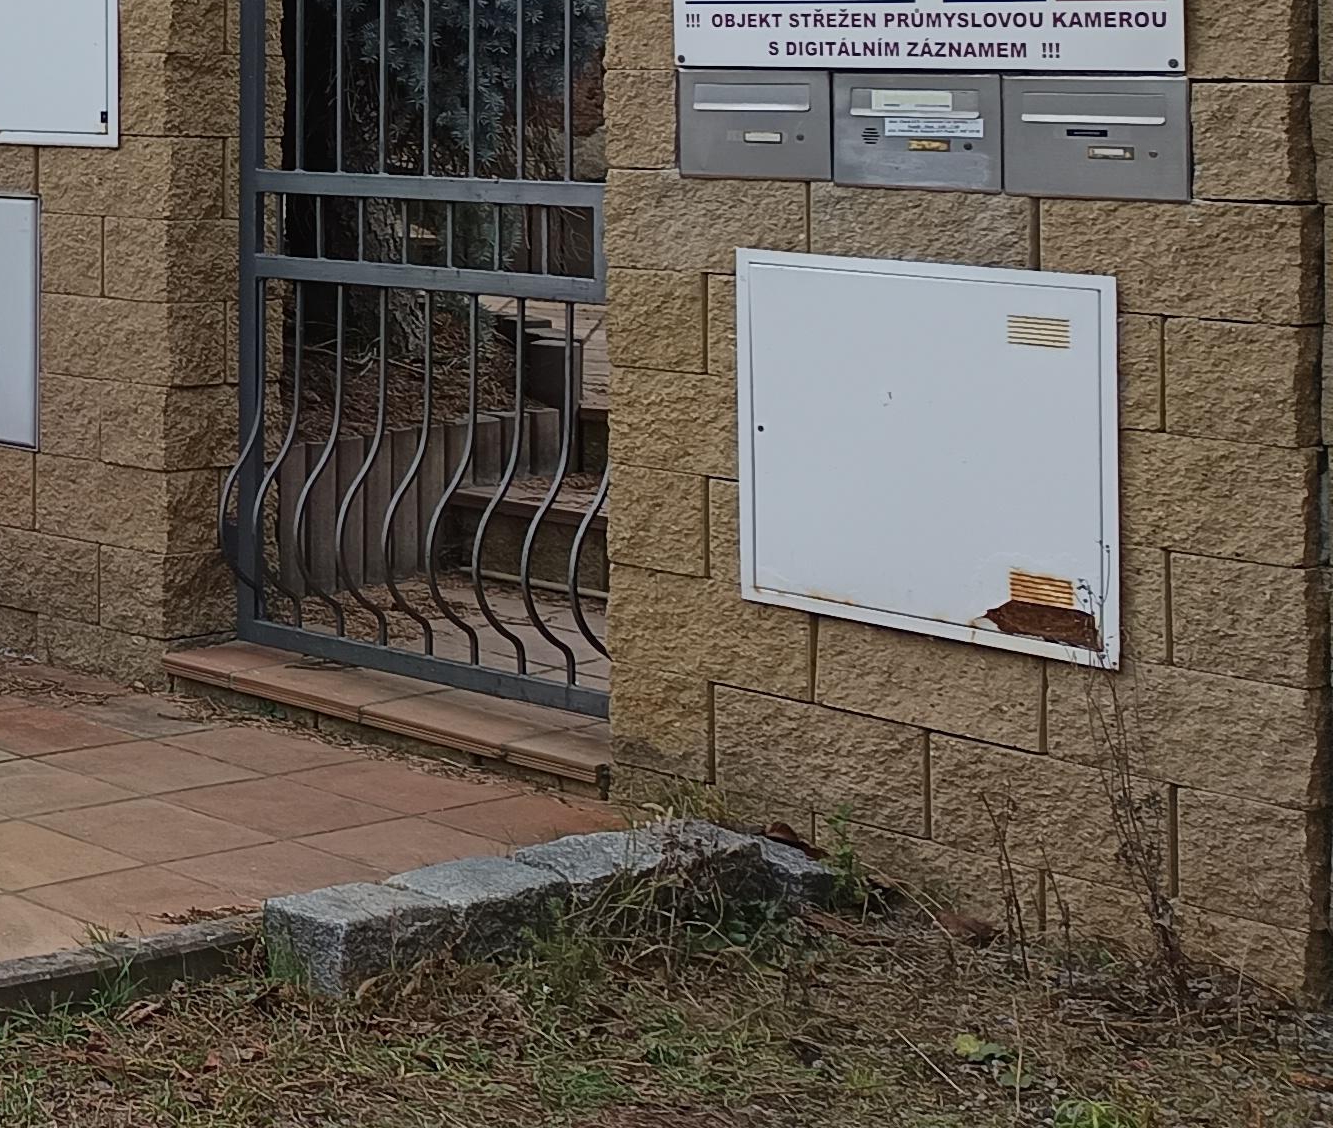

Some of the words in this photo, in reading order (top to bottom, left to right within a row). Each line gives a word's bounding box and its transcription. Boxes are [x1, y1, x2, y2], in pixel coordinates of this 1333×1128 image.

[711, 13, 783, 28] OBJEKT
[789, 8, 877, 28] STŘEŽEN
[884, 8, 1044, 28] PRŮMYSLOVOU
[1052, 11, 1167, 28] KAMEROU
[768, 41, 780, 56] S
[786, 38, 900, 57] DIGITÁLNÍM
[906, 38, 1028, 58] ZÁZNAMEM
